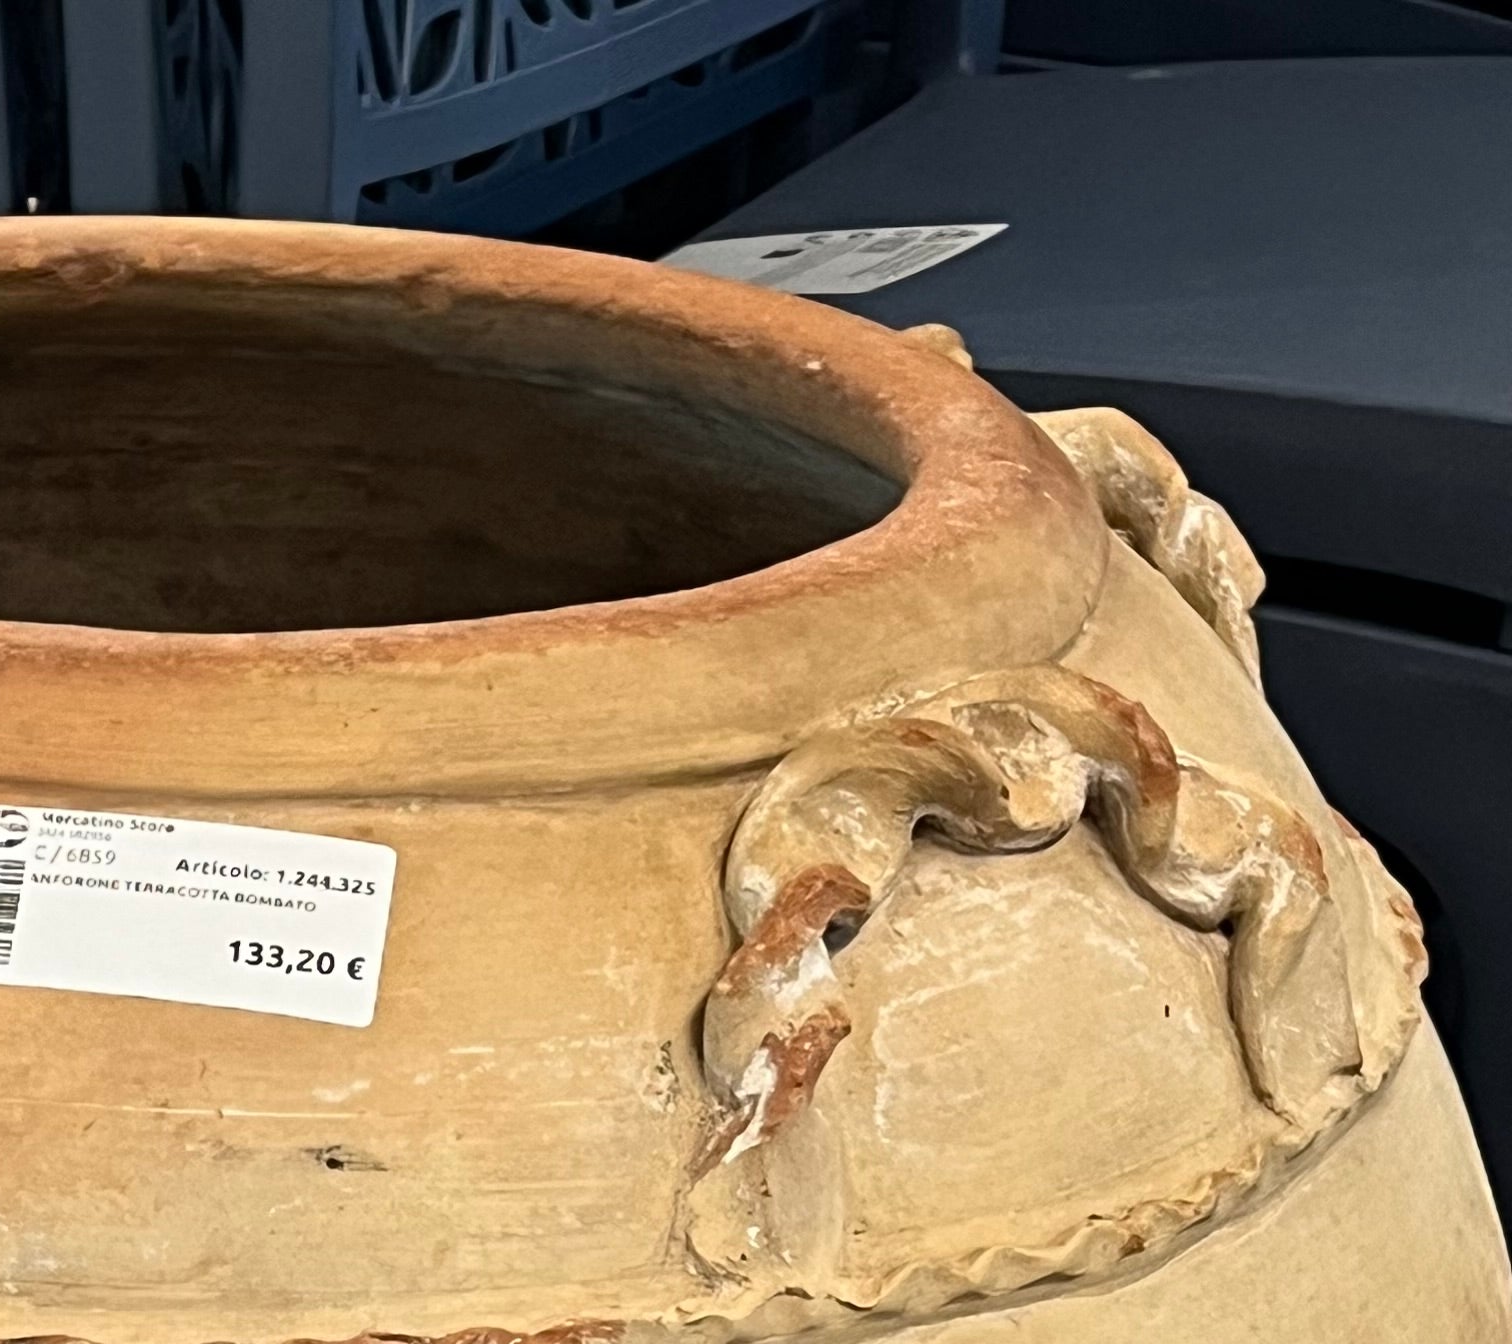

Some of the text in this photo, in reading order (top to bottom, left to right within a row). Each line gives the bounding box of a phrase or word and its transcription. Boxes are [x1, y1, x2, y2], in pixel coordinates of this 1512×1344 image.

[125, 880, 229, 902] TERRACOTTA
[234, 892, 317, 912] BOMBATO
[175, 858, 376, 896] Articolo: 1.244.325
[228, 940, 366, 980] 133,20 €
